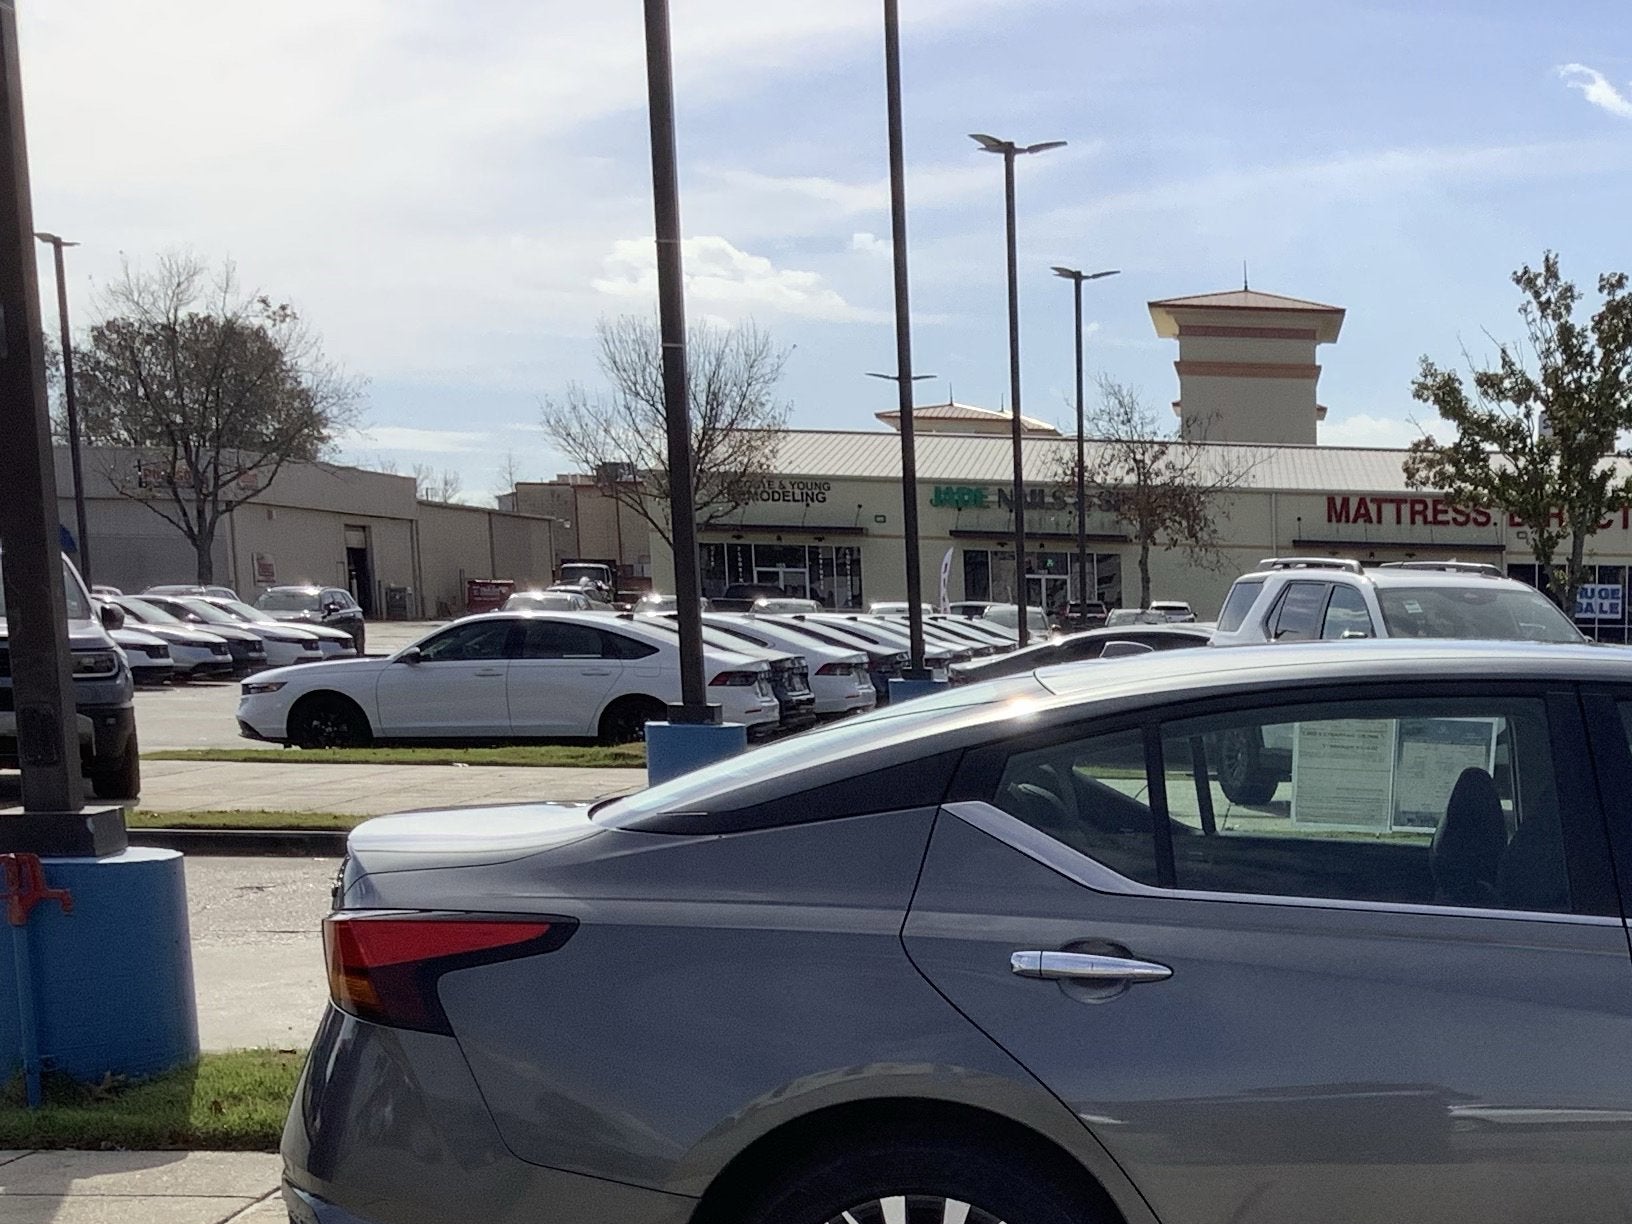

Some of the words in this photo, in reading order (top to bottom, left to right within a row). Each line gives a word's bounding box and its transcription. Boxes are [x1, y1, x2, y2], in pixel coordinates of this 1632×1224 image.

[789, 481, 831, 492] YOUNG
[733, 490, 827, 503] MODELING
[1326, 495, 1492, 528] MATTRESS
